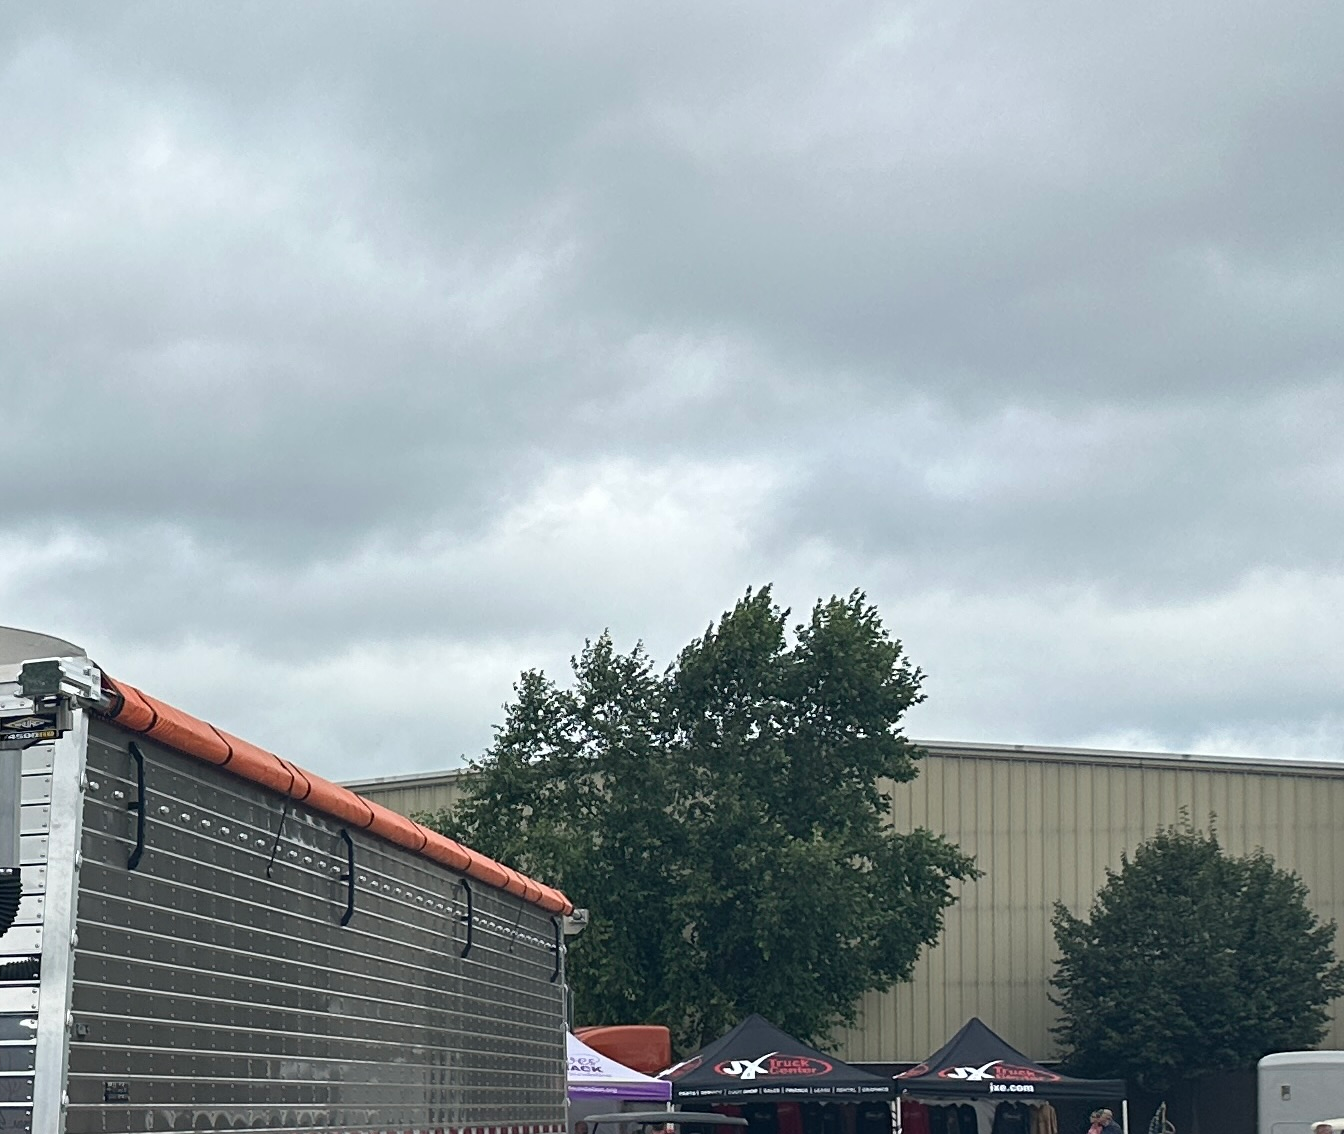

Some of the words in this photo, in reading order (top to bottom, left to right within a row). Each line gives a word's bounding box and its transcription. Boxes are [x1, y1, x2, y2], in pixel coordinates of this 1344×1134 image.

[567, 1064, 604, 1073] ACK
[723, 1051, 780, 1080] JX
[768, 1057, 810, 1068] Truck
[769, 1066, 818, 1076] Center
[947, 1060, 1005, 1081] JX
[989, 1082, 1035, 1094] jxe.com
